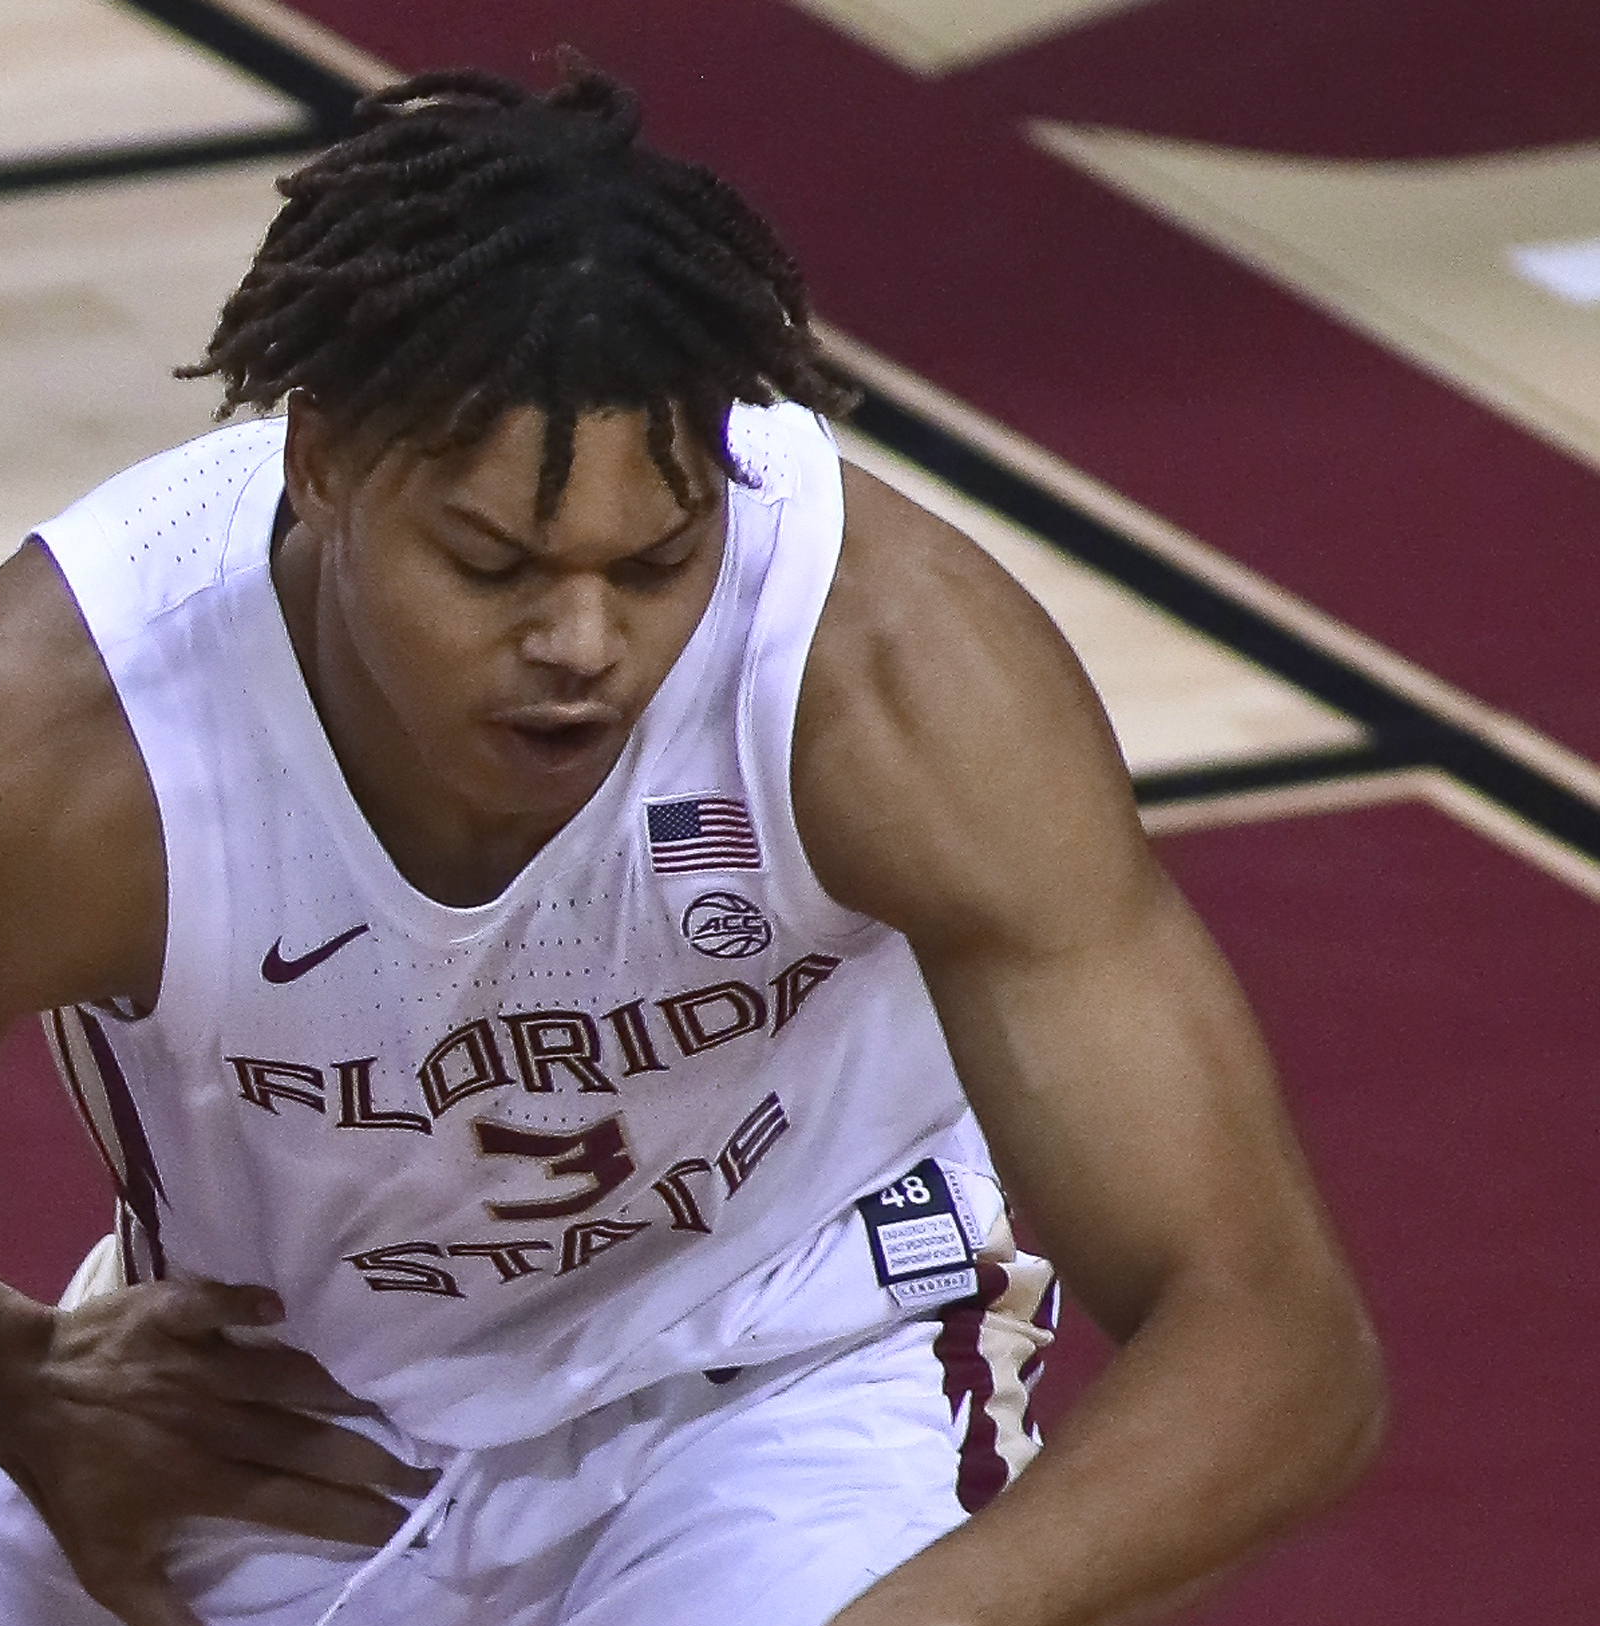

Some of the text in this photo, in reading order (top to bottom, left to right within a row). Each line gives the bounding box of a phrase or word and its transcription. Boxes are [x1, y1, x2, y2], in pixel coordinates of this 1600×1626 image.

[695, 913, 763, 935] ACC
[226, 954, 842, 1136] FLORIDA
[343, 1092, 791, 1299] STATE
[471, 1113, 635, 1222] 3
[880, 1175, 931, 1208] 48
